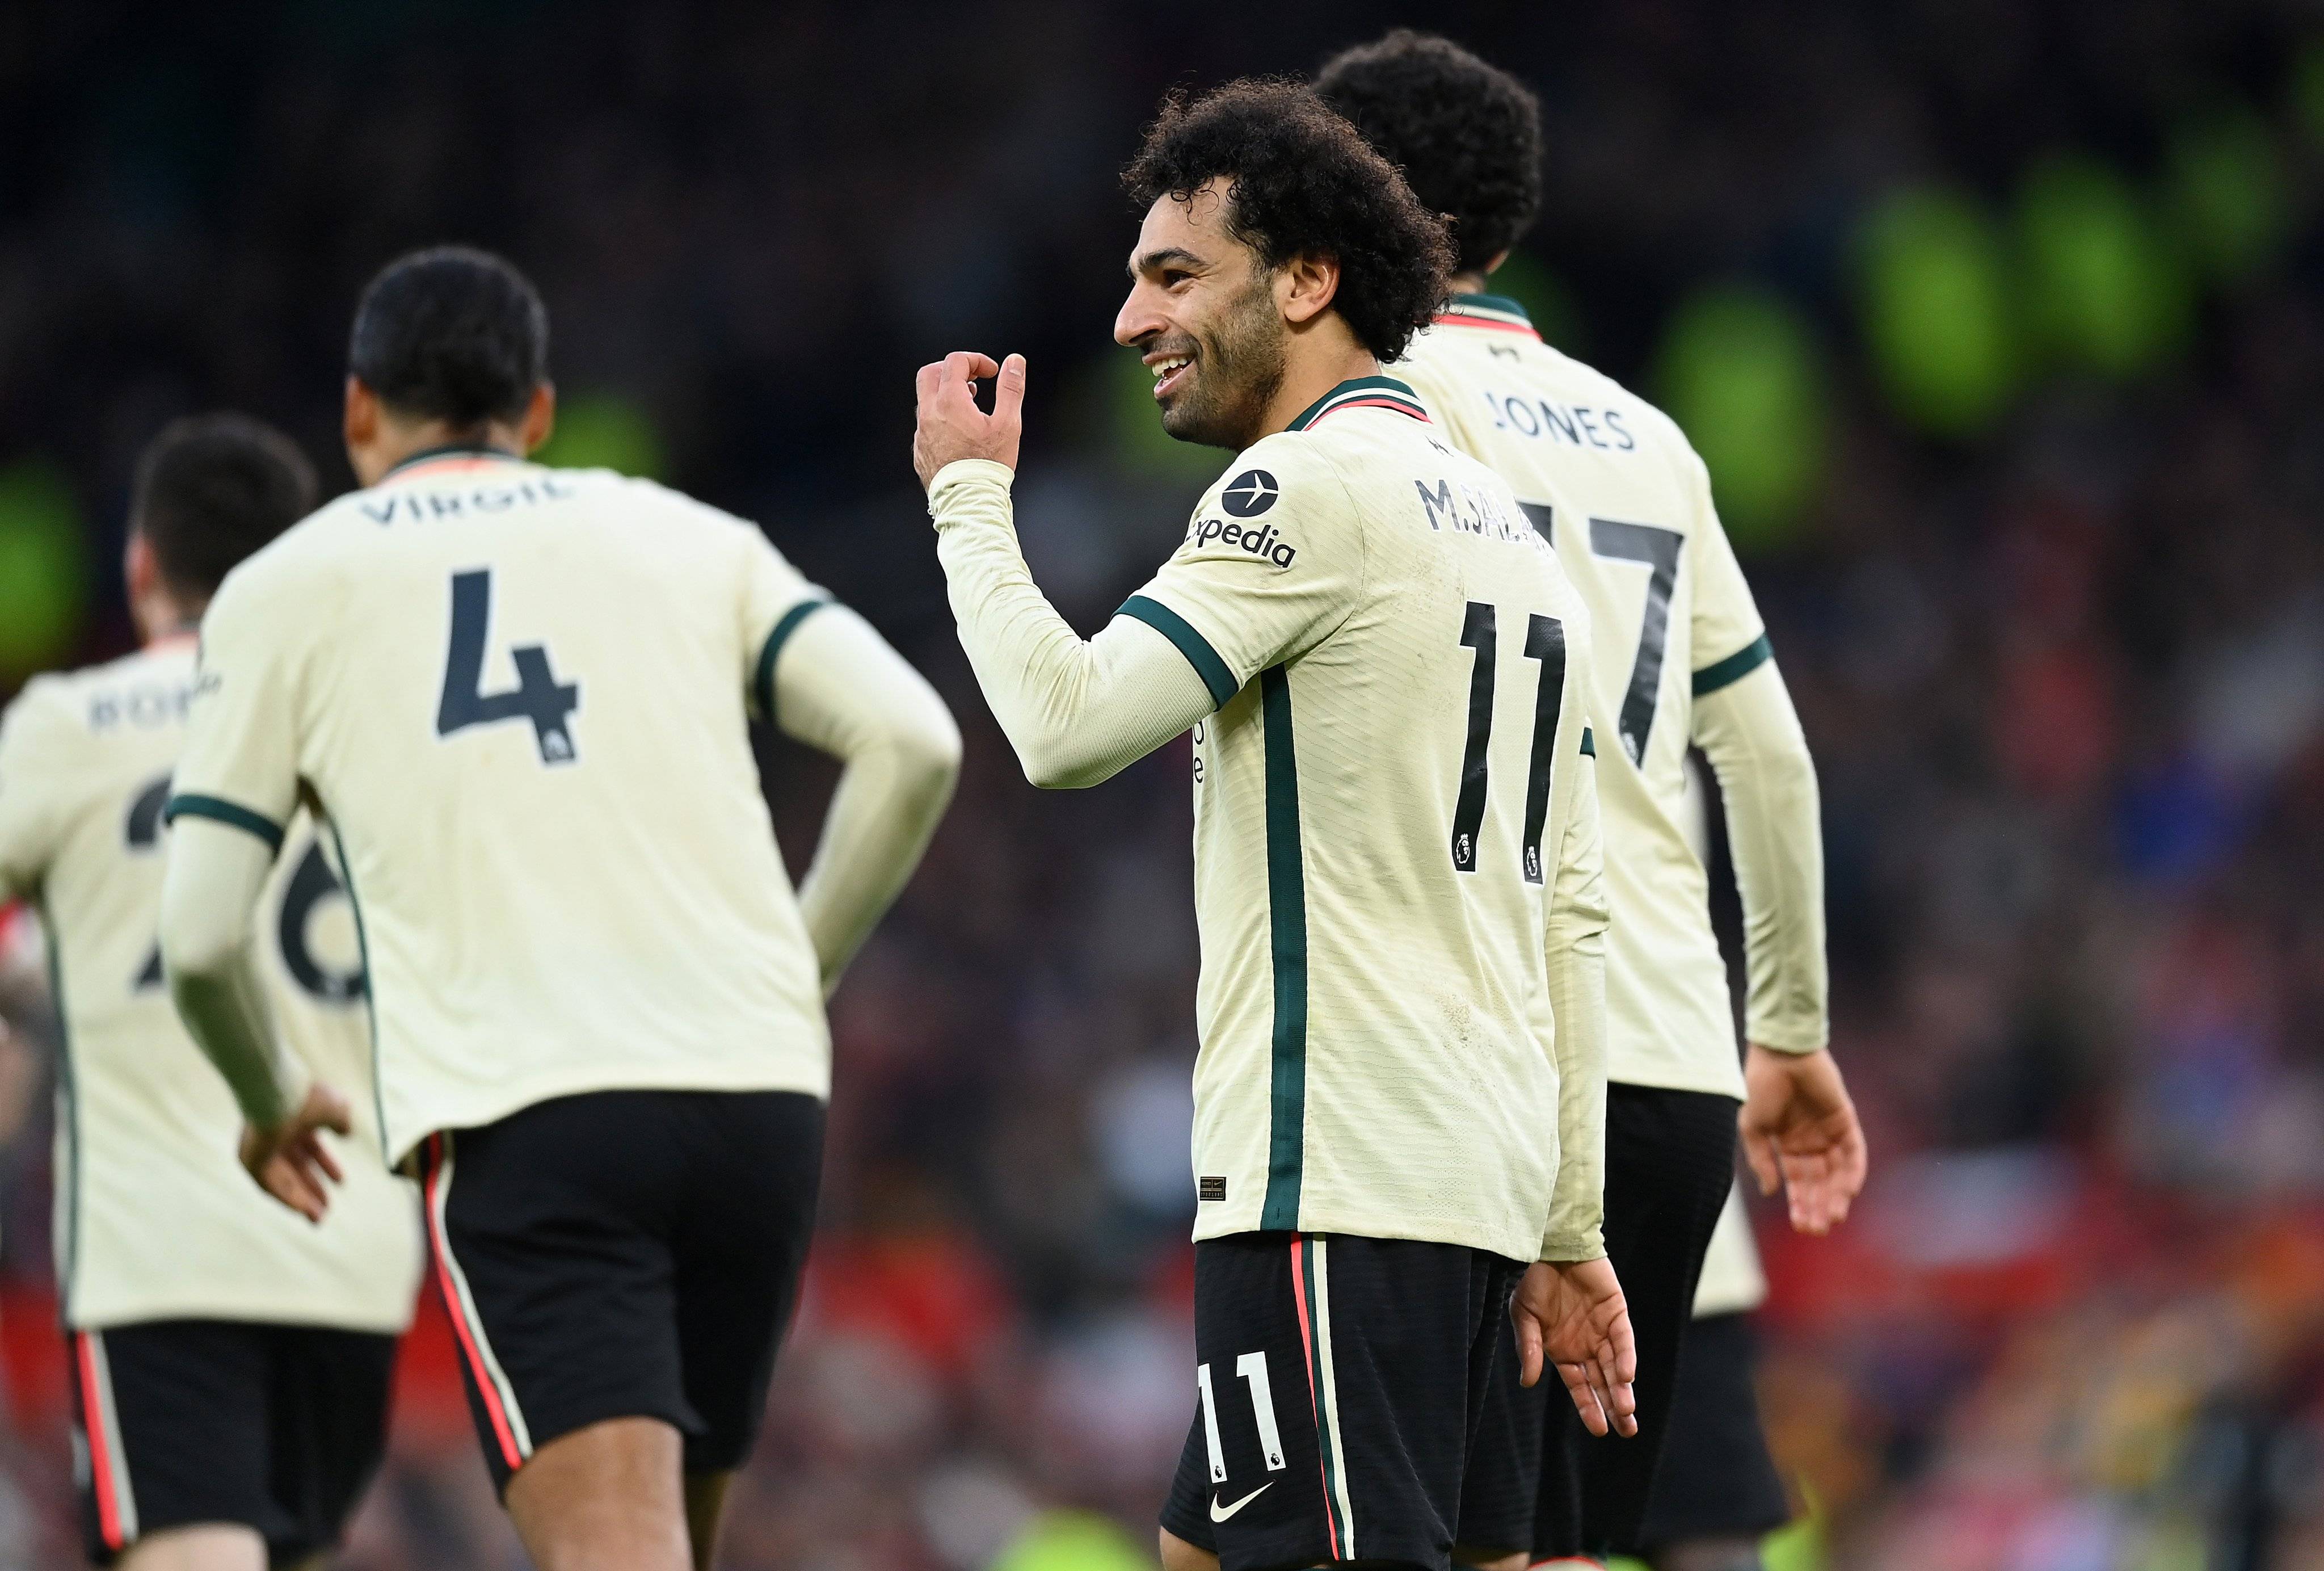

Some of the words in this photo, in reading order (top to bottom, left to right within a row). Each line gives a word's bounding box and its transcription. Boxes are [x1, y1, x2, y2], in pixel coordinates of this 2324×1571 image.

[1484, 390, 1635, 451] JONES
[360, 478, 578, 526] VIRGIL
[1186, 513, 1296, 568] xpedia
[437, 569, 579, 763] 4
[1451, 600, 1566, 884] 11
[1197, 1350, 1287, 1485] 11
